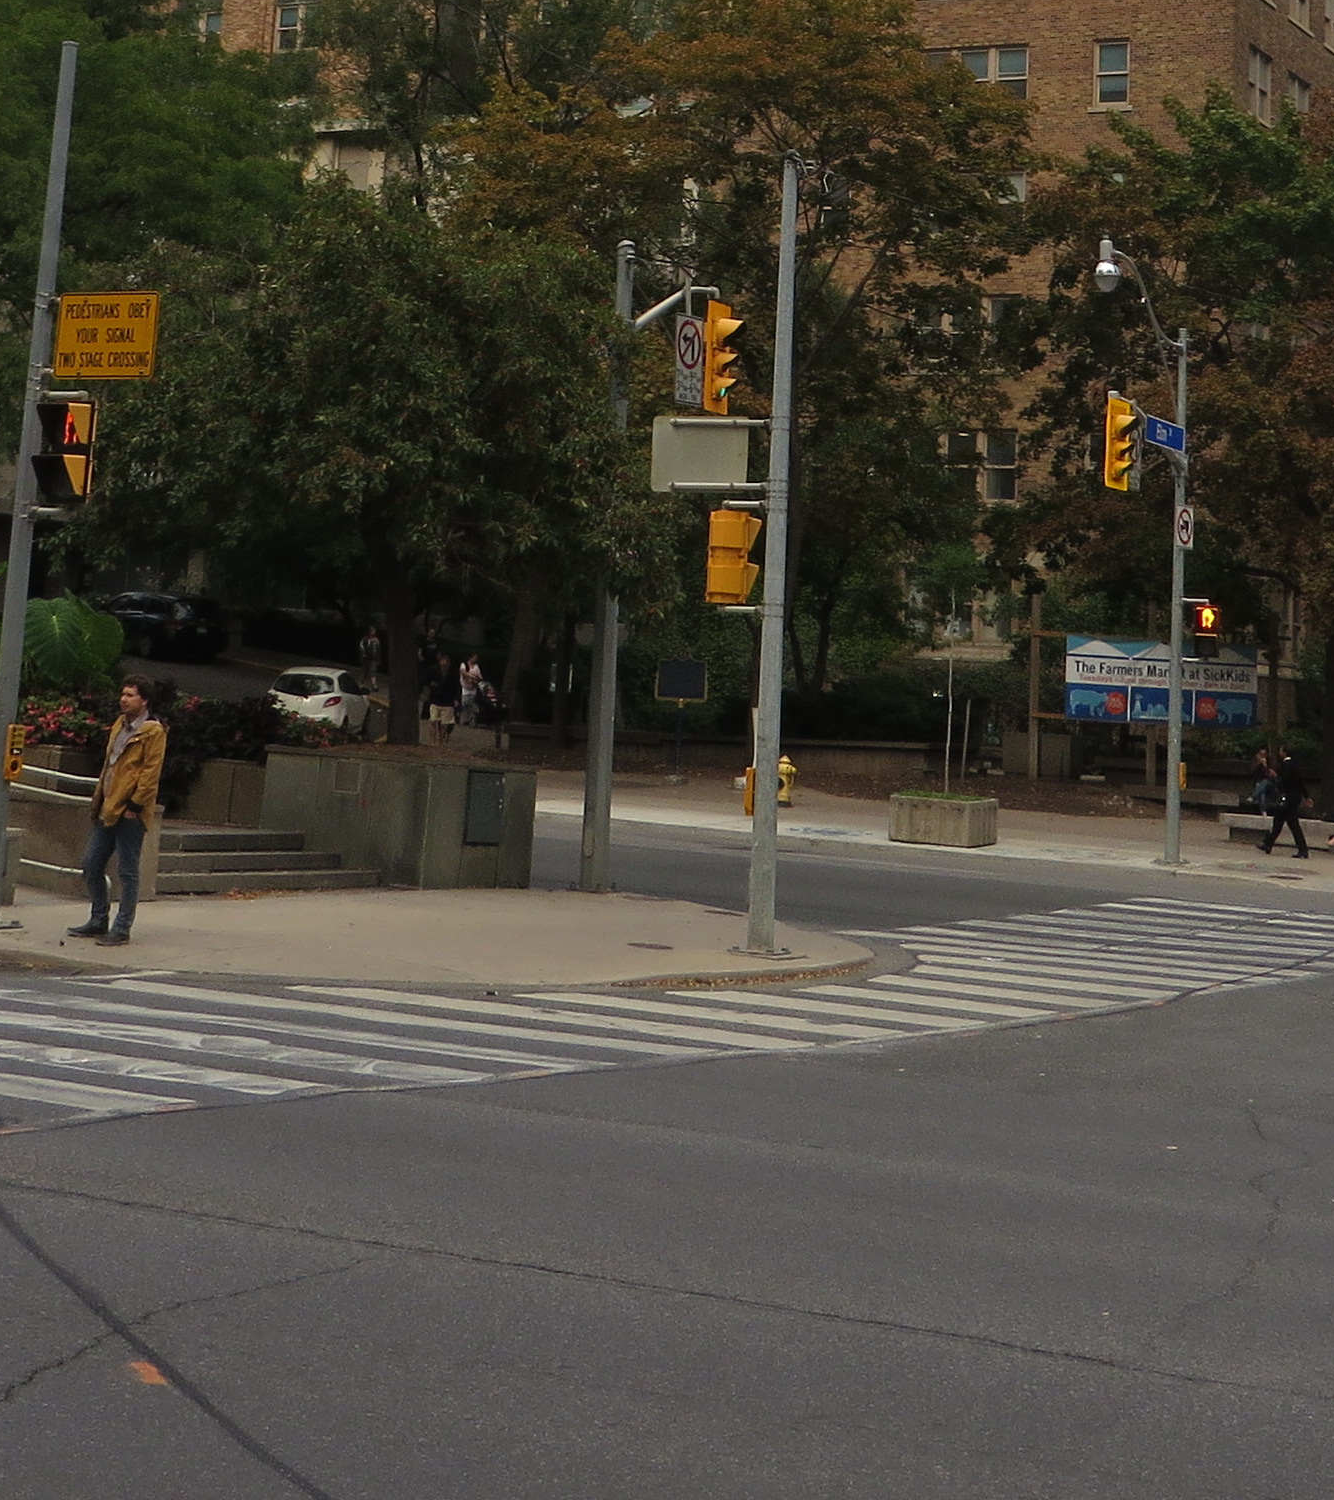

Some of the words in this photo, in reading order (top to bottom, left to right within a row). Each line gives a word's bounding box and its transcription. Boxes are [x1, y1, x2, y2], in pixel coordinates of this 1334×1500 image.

[65, 303, 121, 319] PEDESTRIANS
[128, 302, 153, 319] OBEY
[75, 328, 99, 343] YOUR
[105, 328, 136, 343] SIGNAL
[58, 352, 76, 368] TWO
[78, 352, 105, 368] STAGE
[107, 352, 151, 368] CROSSING
[1074, 660, 1096, 674] The
[1099, 662, 1144, 677] Farmers
[1147, 664, 1185, 679] Mart
[1189, 668, 1200, 679] at
[1203, 668, 1251, 682] SickKids
